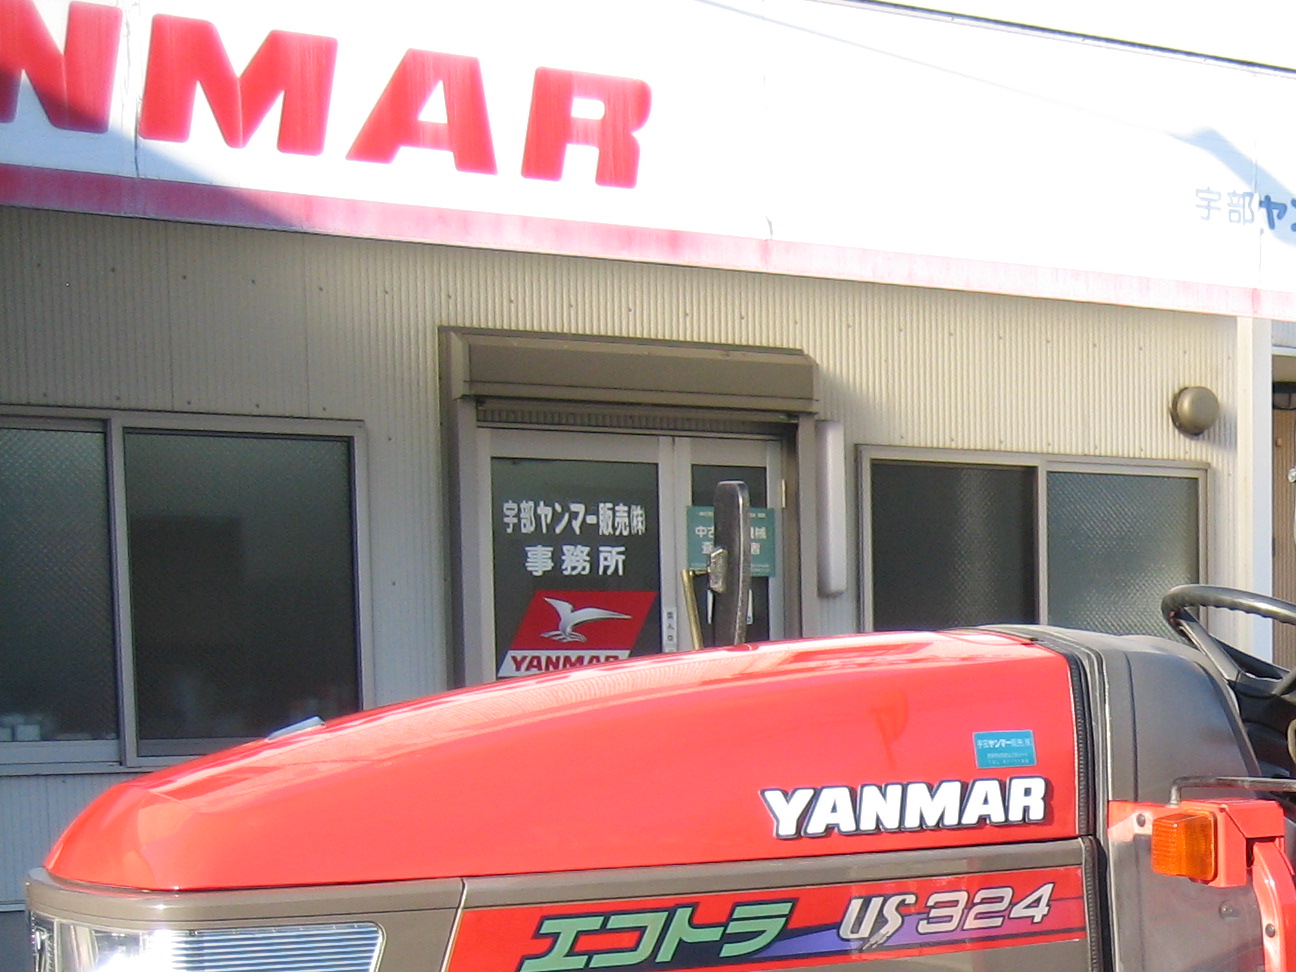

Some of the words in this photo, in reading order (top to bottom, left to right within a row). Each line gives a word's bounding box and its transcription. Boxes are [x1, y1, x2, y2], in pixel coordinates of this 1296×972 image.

[524, 544, 626, 577] 事務所
[760, 776, 1050, 839] YANMAR
